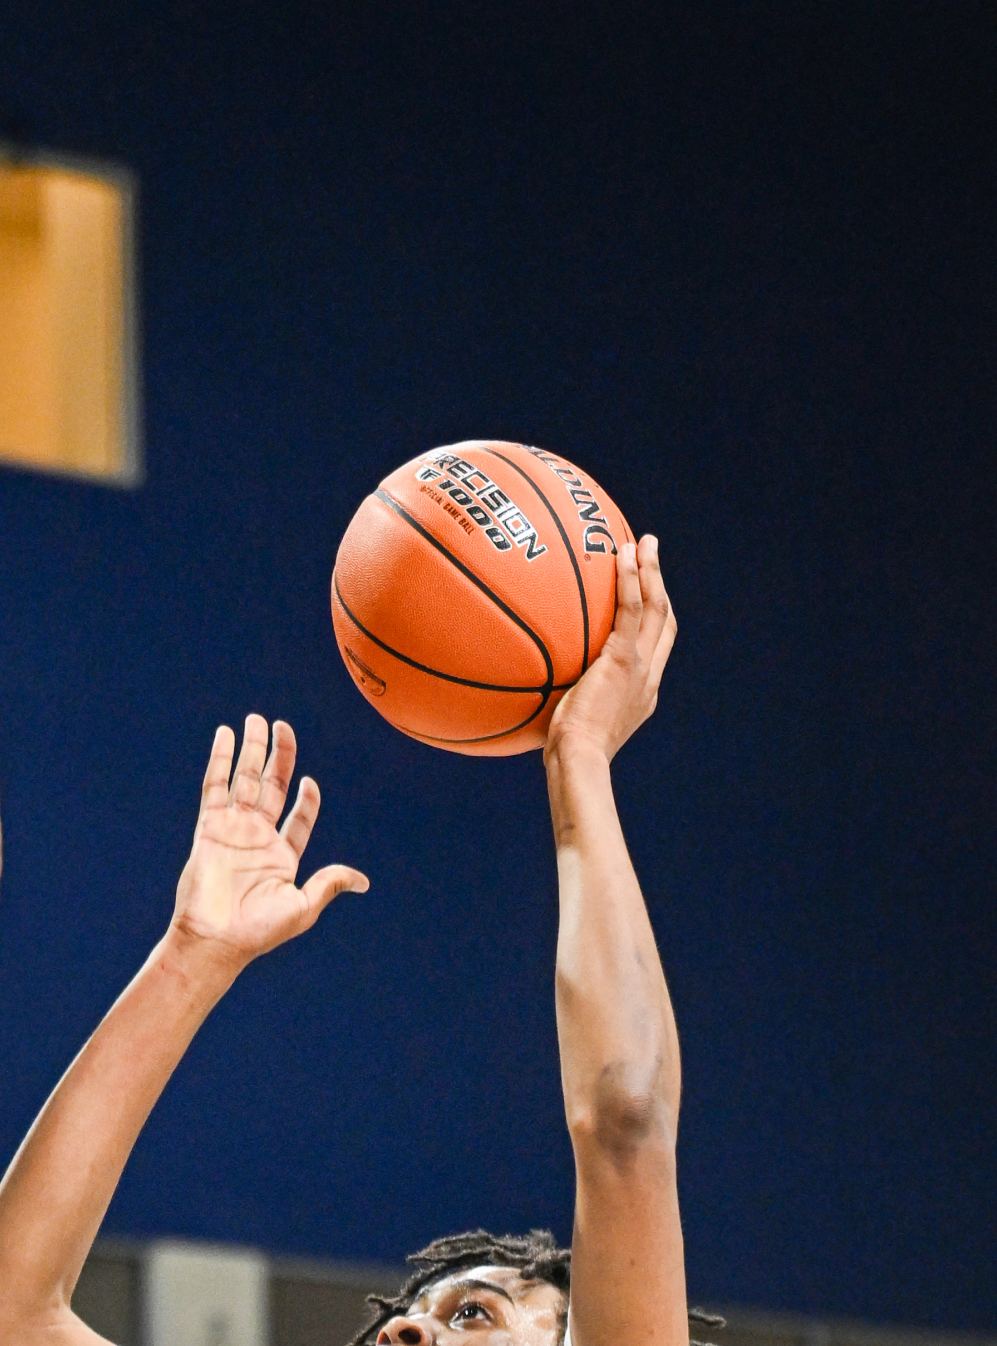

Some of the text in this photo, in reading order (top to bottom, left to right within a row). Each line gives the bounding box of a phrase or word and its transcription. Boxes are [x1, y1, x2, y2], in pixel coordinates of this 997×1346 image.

[437, 478, 512, 552] 1000
[443, 503, 461, 520] GAME
[458, 518, 475, 536] BALL
